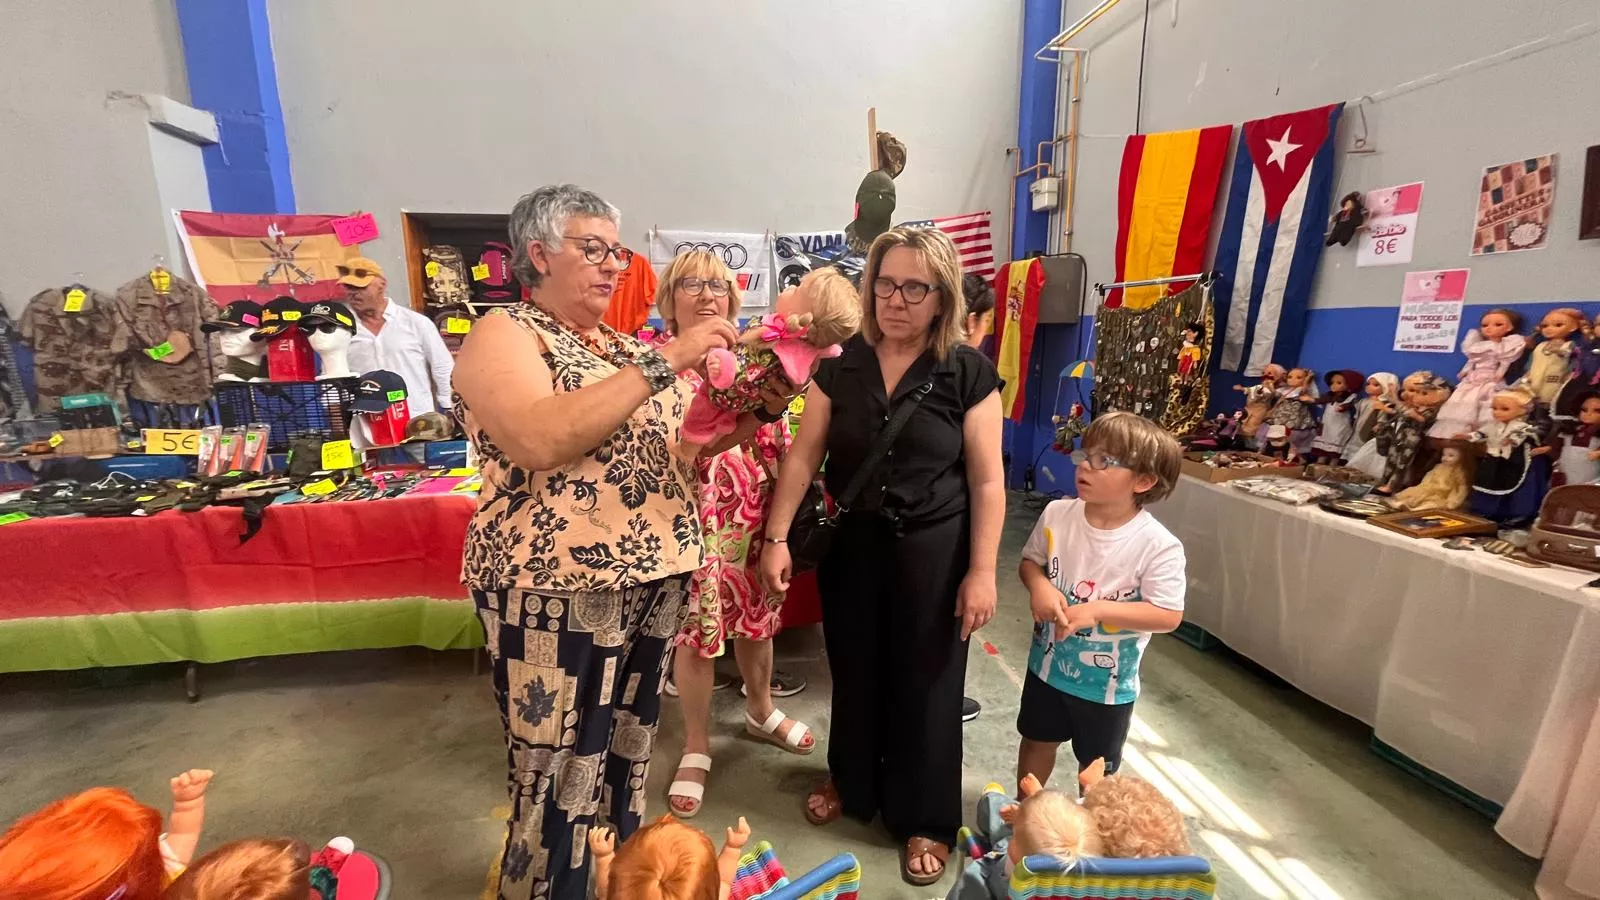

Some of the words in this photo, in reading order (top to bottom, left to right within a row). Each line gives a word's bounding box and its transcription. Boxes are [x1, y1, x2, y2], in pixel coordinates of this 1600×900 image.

[799, 234, 848, 253] YAM
[1374, 238, 1398, 255] 8€
[1414, 322, 1441, 330] GUSTOS
[162, 432, 198, 452] 5€
